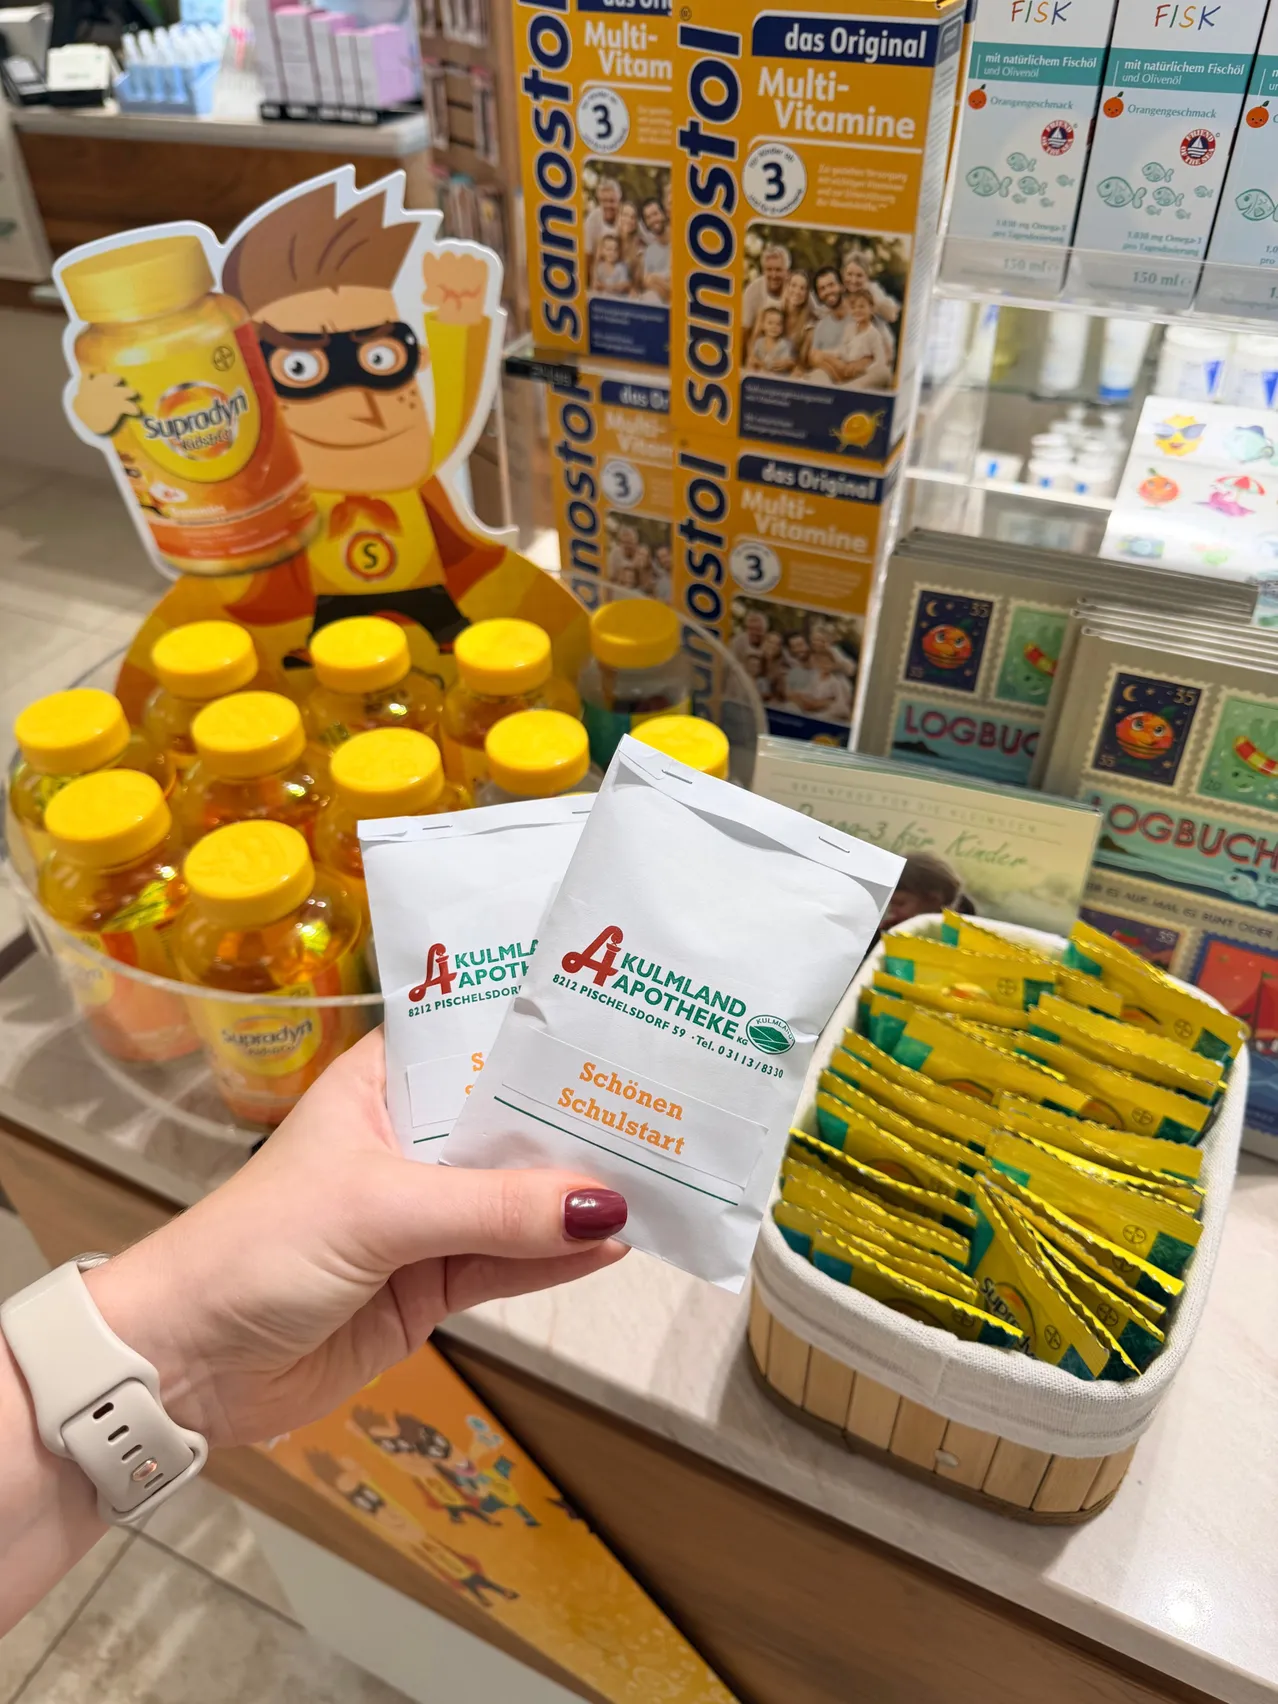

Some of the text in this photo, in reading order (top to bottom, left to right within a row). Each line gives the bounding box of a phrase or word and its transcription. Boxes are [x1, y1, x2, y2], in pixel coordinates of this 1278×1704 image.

[1011, 0, 1072, 25] FISK
[1153, 4, 1221, 30] FISK
[584, 20, 658, 50] Multi-
[785, 23, 825, 52] das
[830, 27, 928, 63] Original
[983, 65, 1040, 79] und Olivenöl
[985, 52, 1098, 68] mit natürlichem Fischöl
[1124, 59, 1246, 76] mit natürlichem Fischöl
[757, 66, 850, 101] Multi-
[1122, 73, 1182, 86] und Olivenöl
[773, 99, 916, 139] Vitamine
[990, 95, 1074, 110] Orangengeschmack
[1127, 103, 1218, 119] Orangengeschmack
[592, 104, 612, 139] 3
[1186, 129, 1214, 142] FRIEND
[762, 162, 786, 201] 3
[677, 23, 742, 425] sanostol
[1132, 270, 1180, 287] 150 ml
[143, 391, 249, 440] Supradyn
[613, 472, 630, 498] 3
[761, 461, 877, 499] das Original
[740, 487, 816, 521] Multi-
[753, 512, 869, 554] Vitamine
[363, 542, 379, 570] S
[744, 554, 763, 582] 3
[944, 830, 1030, 867] Kinder
[1093, 797, 1278, 874] OGBUCH
[620, 952, 747, 1018] KULMLAND
[408, 1003, 432, 1018] 8212
[552, 973, 578, 992] 8212
[578, 984, 671, 1031] PISCHELSDORF
[671, 1023, 687, 1038] 59
[611, 973, 749, 1046] APOTHEKE KG
[579, 1061, 684, 1121] Schönen
[557, 1087, 685, 1155] Schulstart
